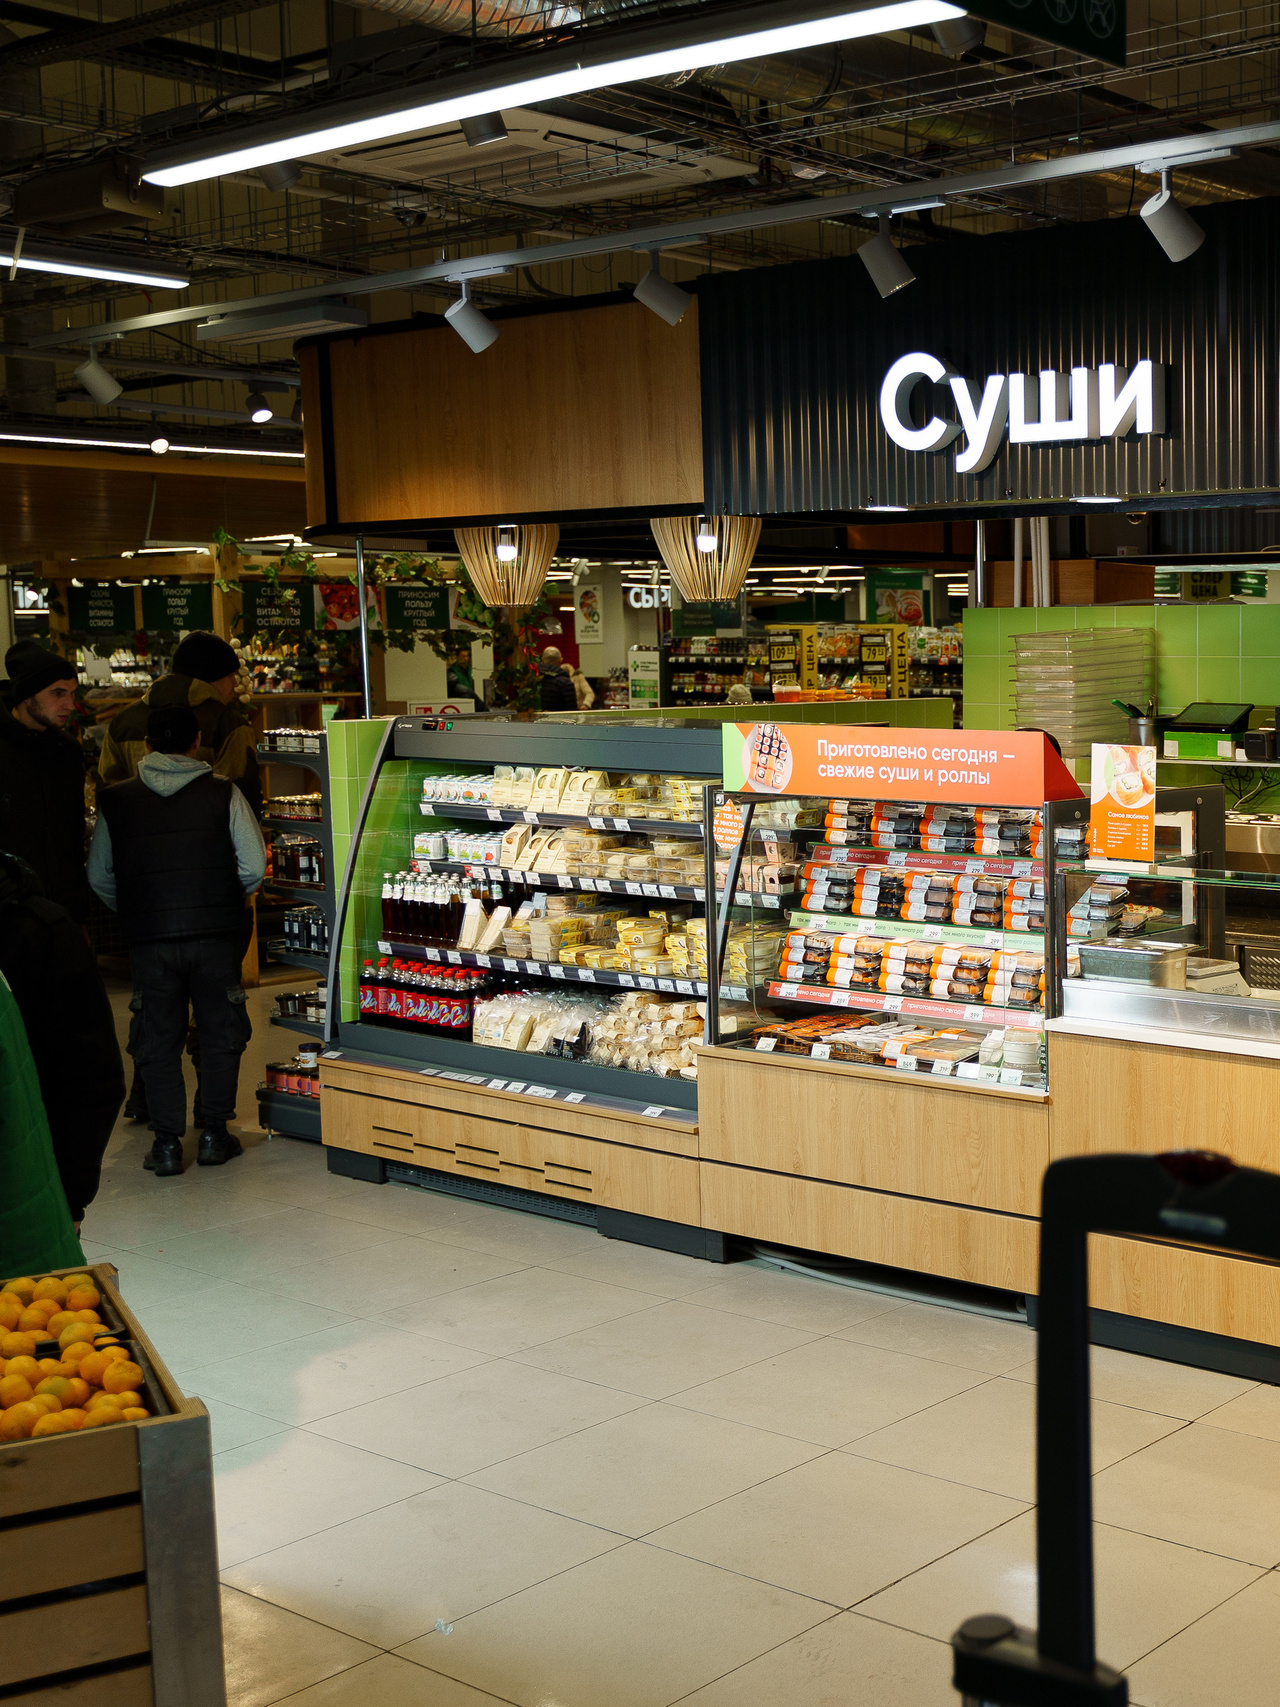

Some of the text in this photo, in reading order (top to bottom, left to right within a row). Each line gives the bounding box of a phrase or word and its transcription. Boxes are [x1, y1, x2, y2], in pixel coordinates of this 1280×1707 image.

[880, 352, 1153, 474] Суши
[398, 591, 440, 599] ПРИНОСИМ
[629, 587, 672, 608] СЫР
[1191, 585, 1218, 598] ЦЕНА
[403, 608, 435, 617] КРУГЛЫЙ
[405, 600, 433, 608] ПОЛЬЗУ
[413, 618, 427, 627] ГОД
[806, 634, 814, 671] ЦЕНА
[897, 631, 906, 684] ЦЕНА
[817, 739, 928, 760] Приготовлено
[931, 746, 998, 765] сегодня
[817, 763, 990, 786] свежие суши и роллы
